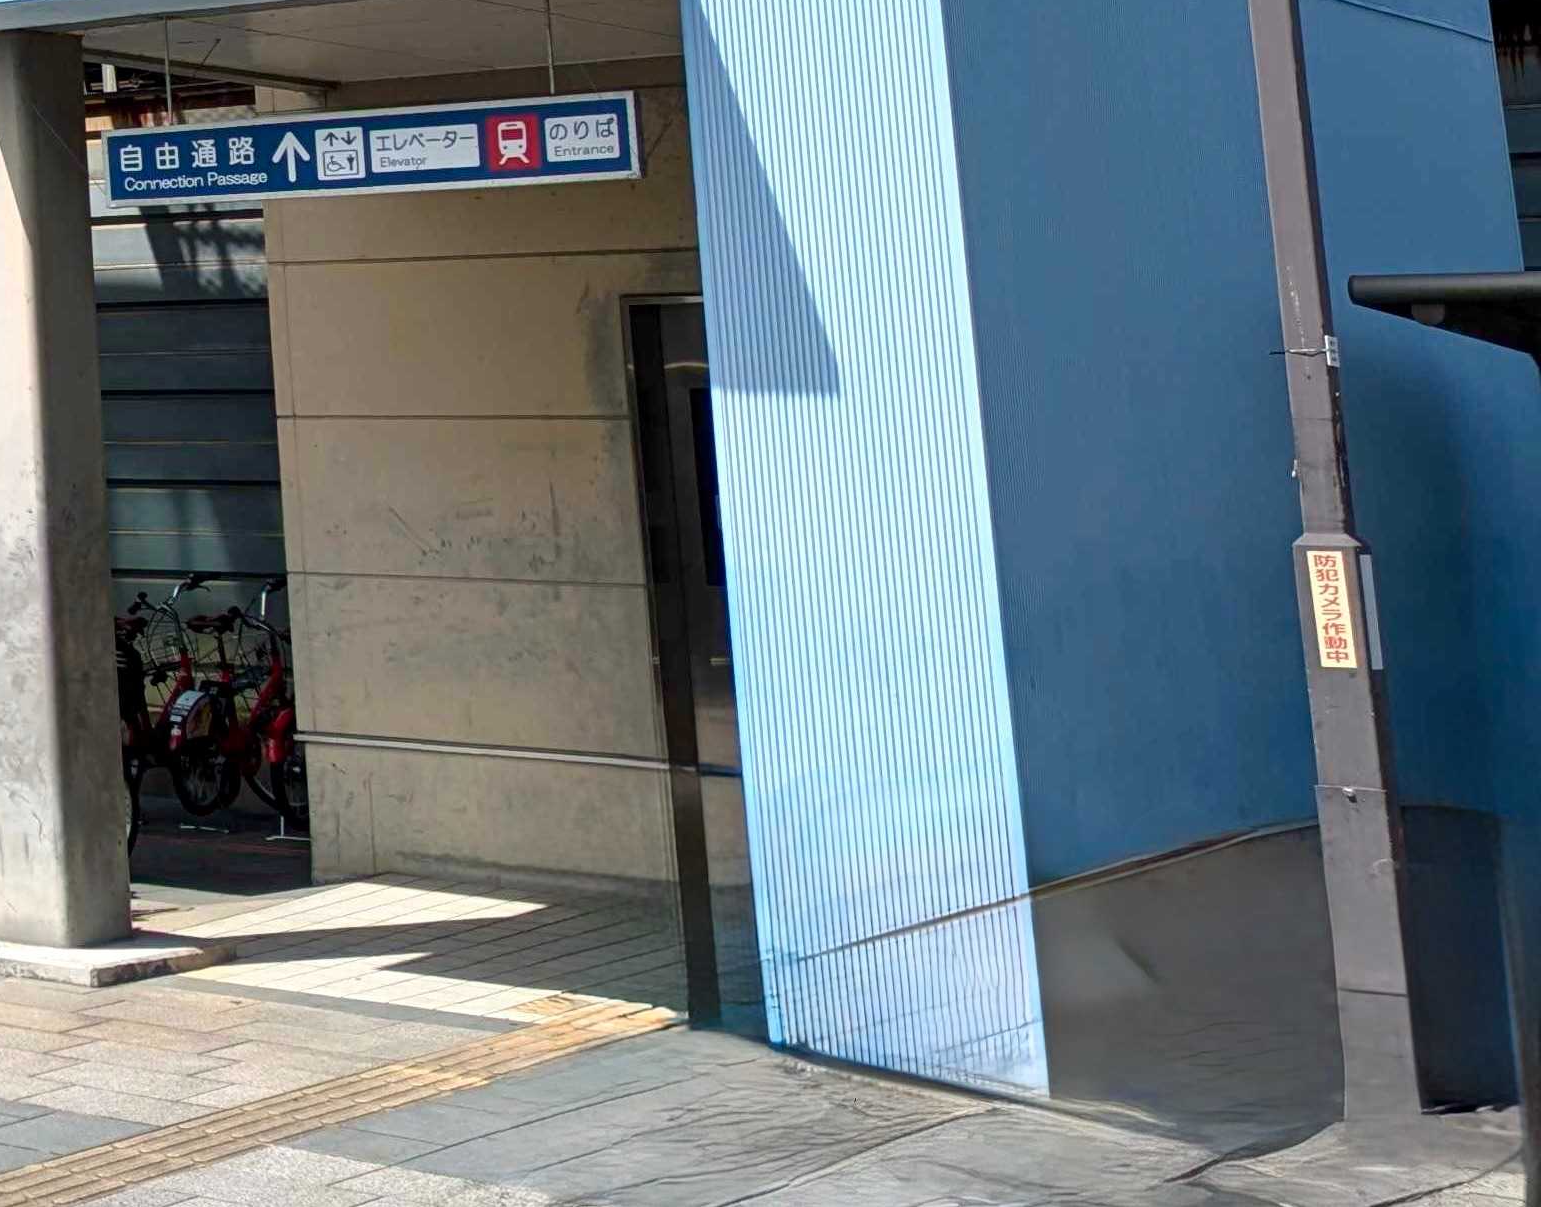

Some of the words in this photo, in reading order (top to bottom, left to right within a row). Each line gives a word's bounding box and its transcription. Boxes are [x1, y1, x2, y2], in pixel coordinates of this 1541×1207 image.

[549, 117, 615, 140] のりば
[375, 130, 475, 152] エレベーター
[554, 145, 614, 157] Entrance
[120, 136, 255, 172] 自由通路
[380, 156, 428, 168] Elevator
[124, 174, 204, 192] Connection
[207, 171, 268, 187] Passage
[1312, 554, 1350, 663] 防犯カメラ作動中
